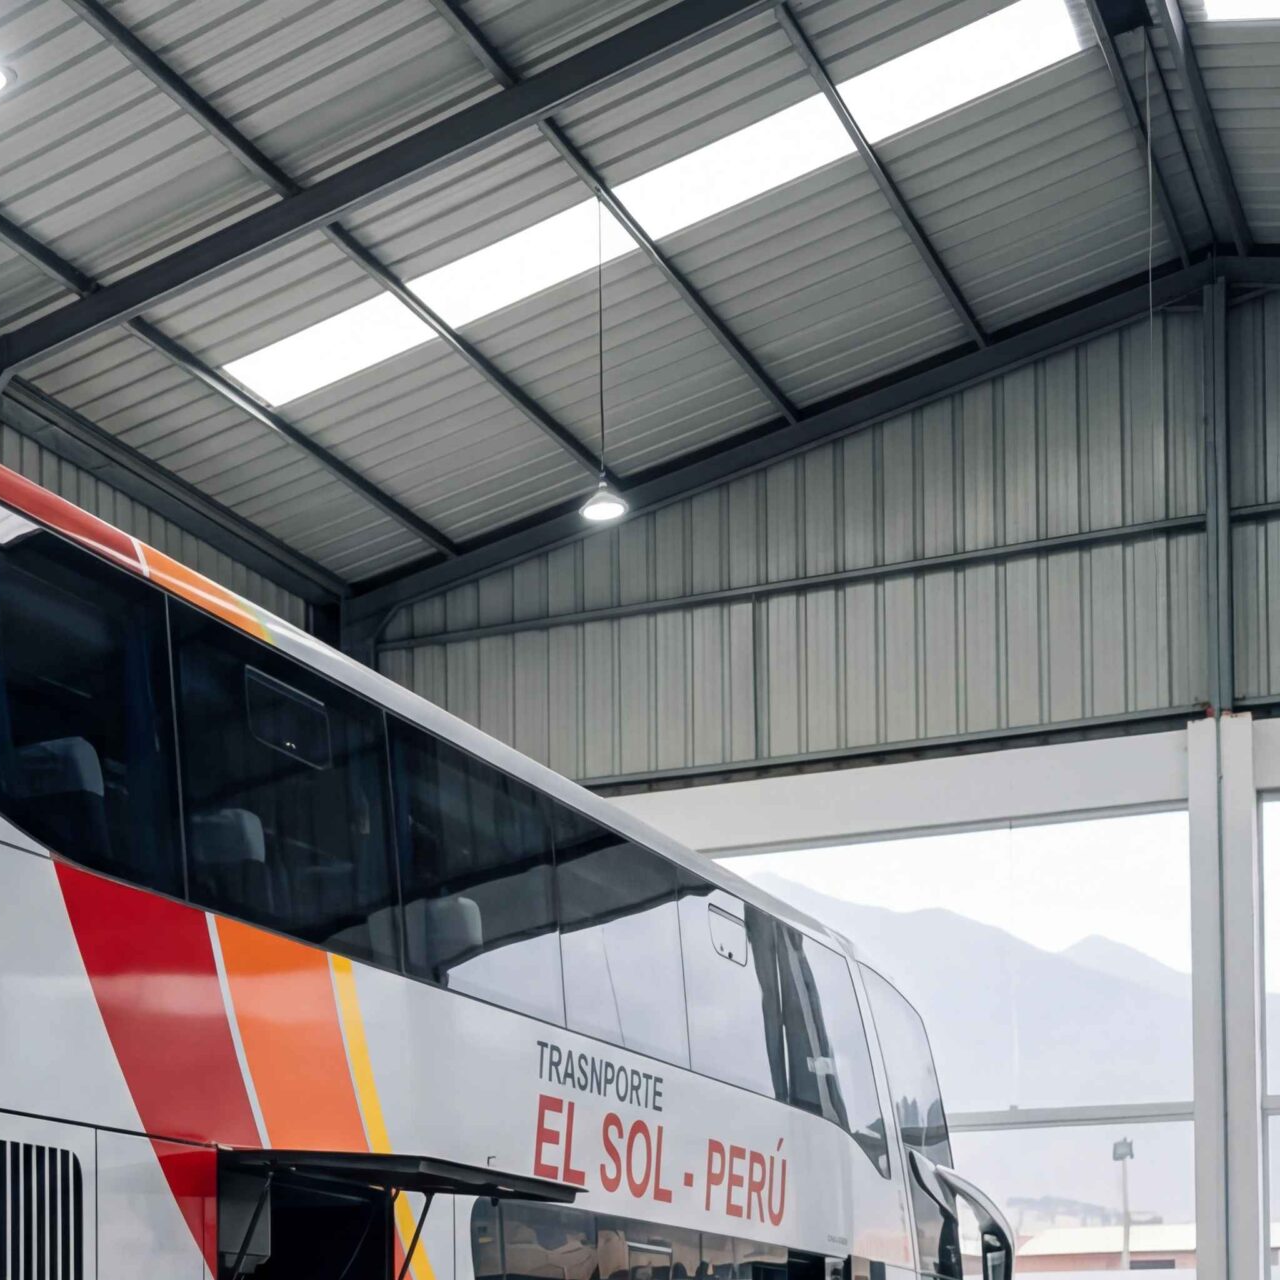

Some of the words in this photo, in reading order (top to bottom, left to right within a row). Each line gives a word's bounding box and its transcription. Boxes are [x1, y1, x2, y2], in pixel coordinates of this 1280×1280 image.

[536, 1040, 663, 1112] TRASNPORTE
[533, 1094, 585, 1186] EL
[600, 1112, 673, 1203] SOL
[705, 1138, 787, 1227] PERÚ
